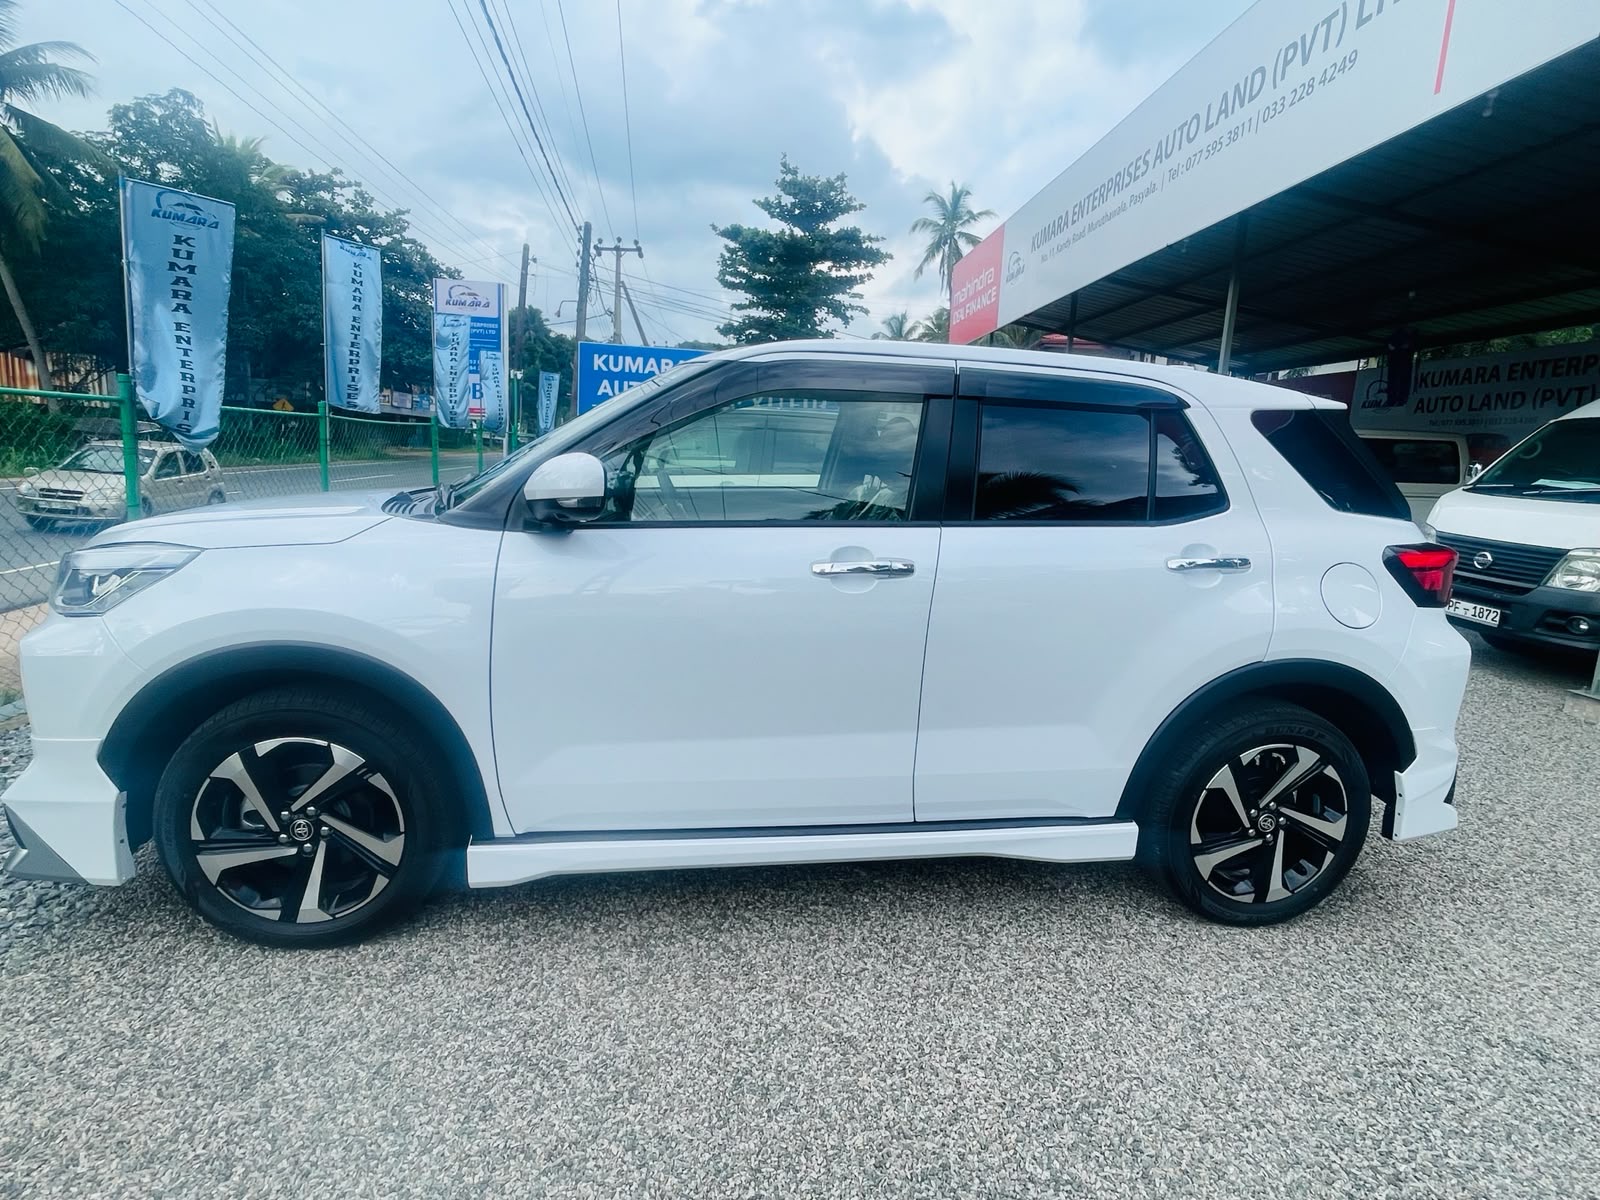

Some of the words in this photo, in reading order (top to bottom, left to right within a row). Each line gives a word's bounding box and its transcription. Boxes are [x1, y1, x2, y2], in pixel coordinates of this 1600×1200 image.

[1031, 210, 1069, 253] KUMARA
[1070, 149, 1151, 226] ENTERPRISES
[1152, 112, 1201, 169] AUTO
[1204, 65, 1267, 133] LAND
[1271, 1, 1348, 90] (PVT)
[1185, 149, 1204, 172] 077
[1204, 138, 1223, 160] 595
[1225, 117, 1253, 147] 3811
[1262, 96, 1286, 123] 033
[1288, 76, 1315, 108] 228
[1318, 49, 1358, 87] 4249
[151, 207, 220, 230] KUMARA
[167, 234, 197, 315] KUMARA
[351, 262, 364, 311] KUMARA
[445, 299, 490, 309] KUMARA
[965, 285, 997, 317] FINANCE
[346, 315, 361, 409] ENTERPRISES
[593, 353, 686, 375] KUMAR
[1419, 364, 1501, 389] KUMARA
[1507, 353, 1600, 382] ENTERP
[1414, 394, 1464, 414] AUTO
[1468, 390, 1526, 413] LAND
